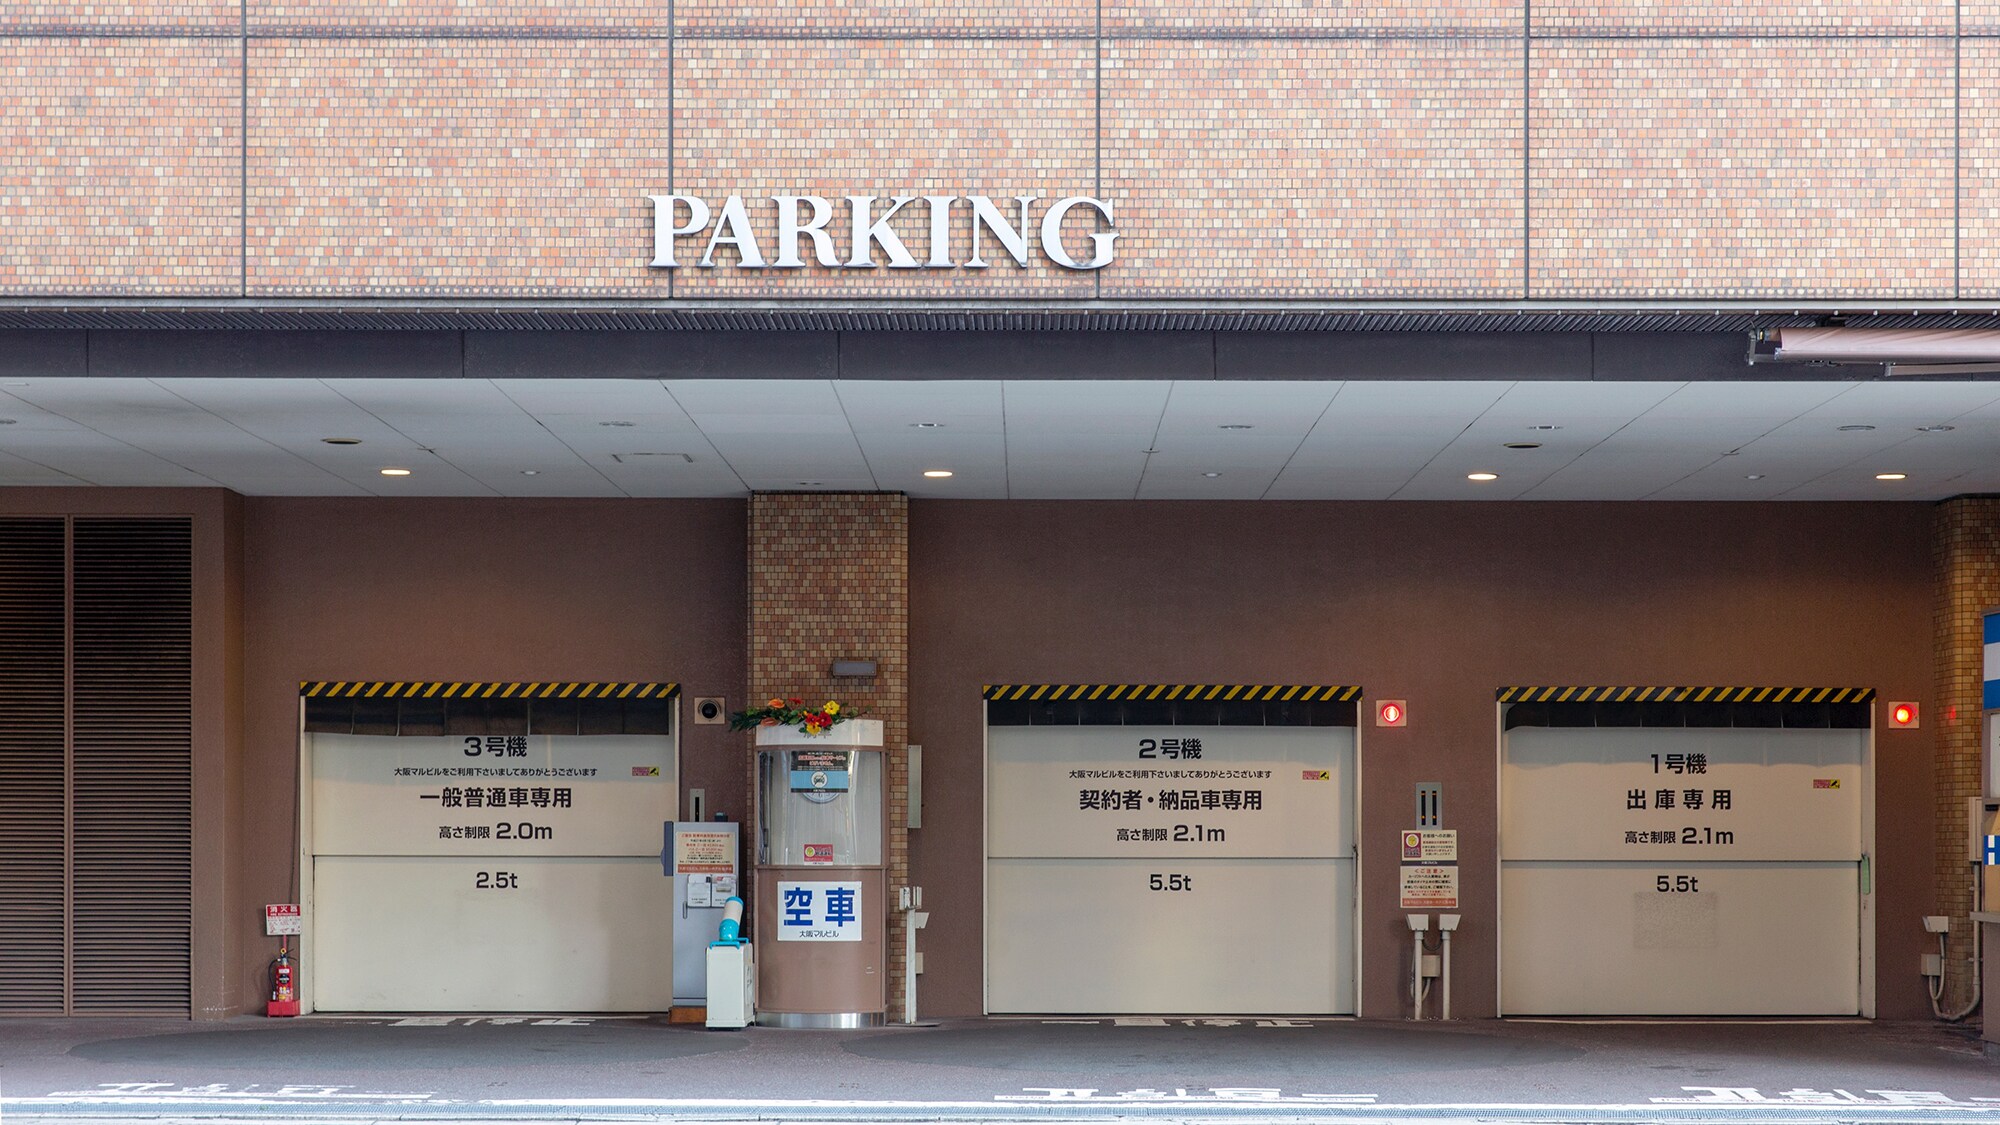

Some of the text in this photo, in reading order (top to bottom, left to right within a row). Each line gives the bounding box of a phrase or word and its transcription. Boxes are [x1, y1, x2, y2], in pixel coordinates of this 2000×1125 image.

[647, 195, 1120, 269] PARKING
[463, 736, 528, 758] 3号機
[1138, 738, 1202, 760] 2号機
[394, 767, 598, 777] 大阪マルビルをご利用下さいましてありがとうございます
[1650, 753, 1707, 775] 1号機
[1068, 769, 1272, 779] 大阪マルビルをご利用下さいましてありがとうございます
[419, 787, 572, 809] 一般普通車専用
[1079, 788, 1262, 811] 契約者・納品車専用
[1626, 788, 1732, 811] 出庫専用
[438, 822, 553, 840] 高さ制限 2.0m
[1116, 825, 1226, 842] 高さ制限 2.1m
[1624, 827, 1734, 845] 高さ制限 2.1m
[475, 872, 519, 889] 2.5t
[1149, 873, 1192, 892] 5.5t
[1656, 875, 1699, 893] 5.5t
[783, 886, 856, 928] 空車
[799, 929, 840, 938] 大阪マルビル
